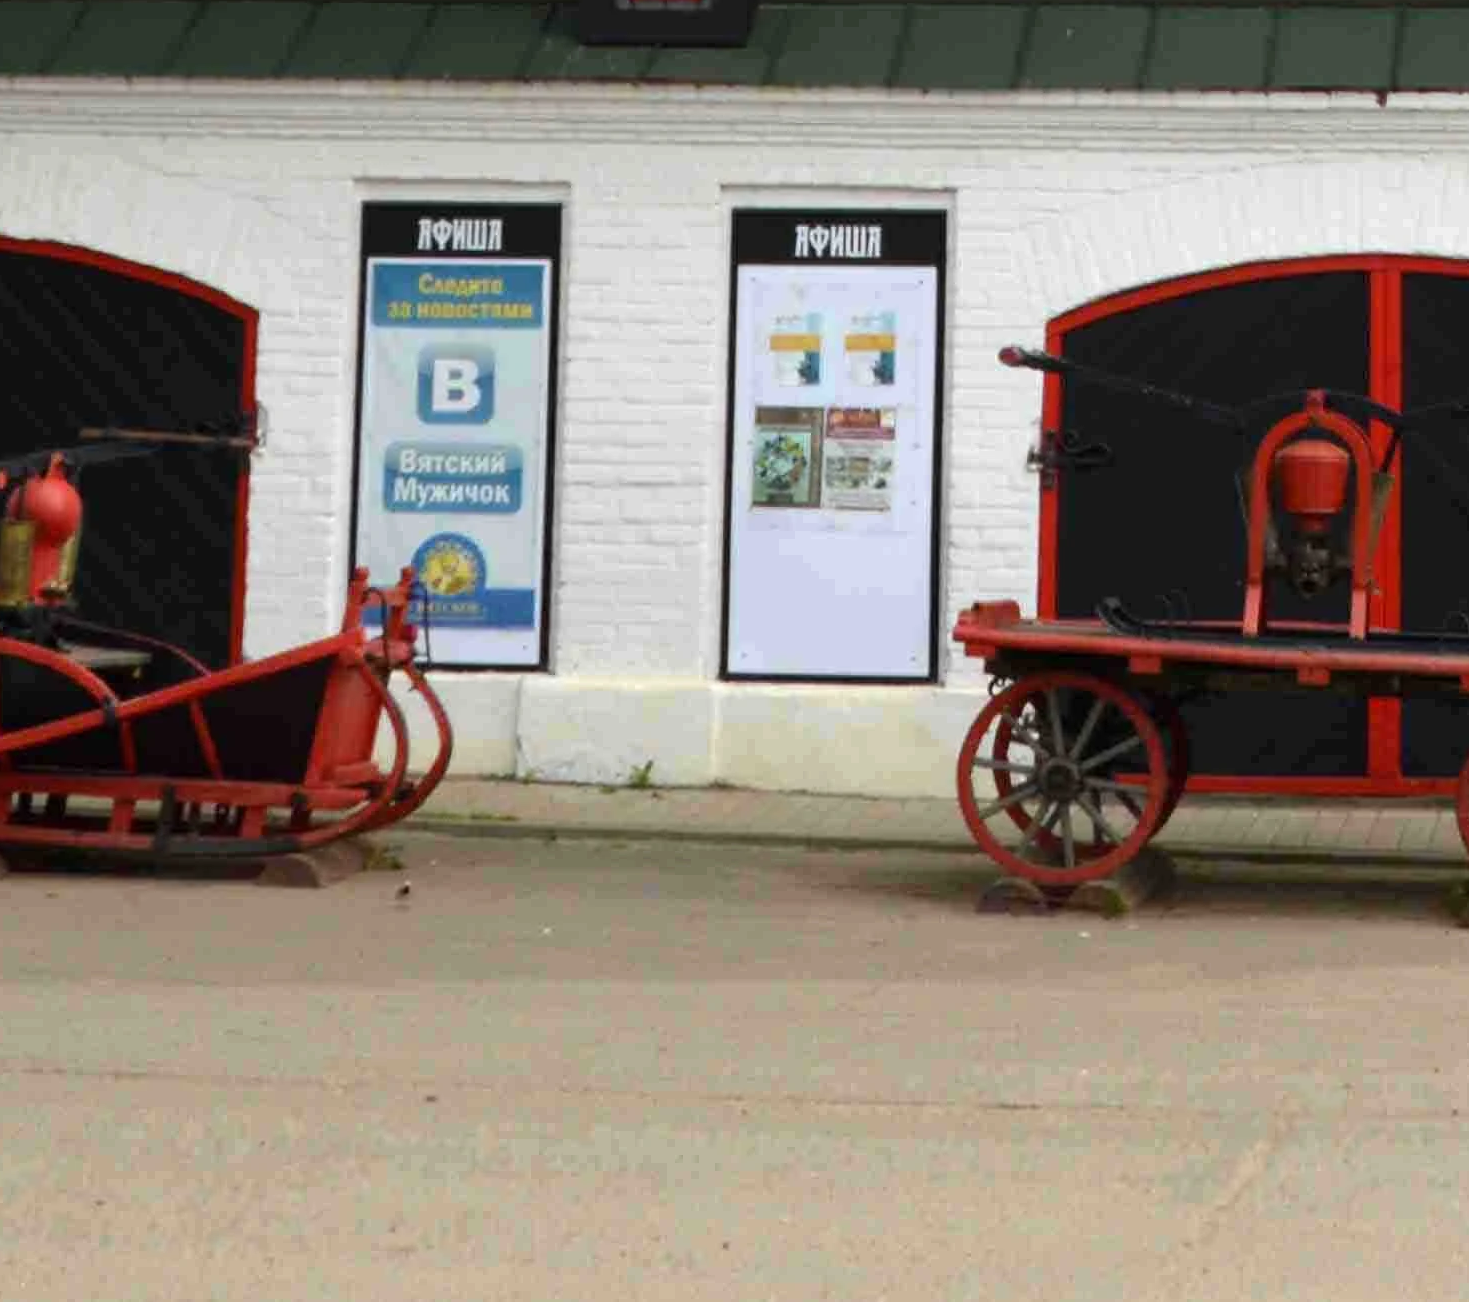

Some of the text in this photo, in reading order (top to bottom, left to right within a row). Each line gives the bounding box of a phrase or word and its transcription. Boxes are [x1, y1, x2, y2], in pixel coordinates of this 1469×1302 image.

[417, 217, 504, 252] АФИША
[794, 224, 883, 259] АФИША
[400, 449, 506, 474] Вятский
[394, 477, 511, 508] Мужичок
